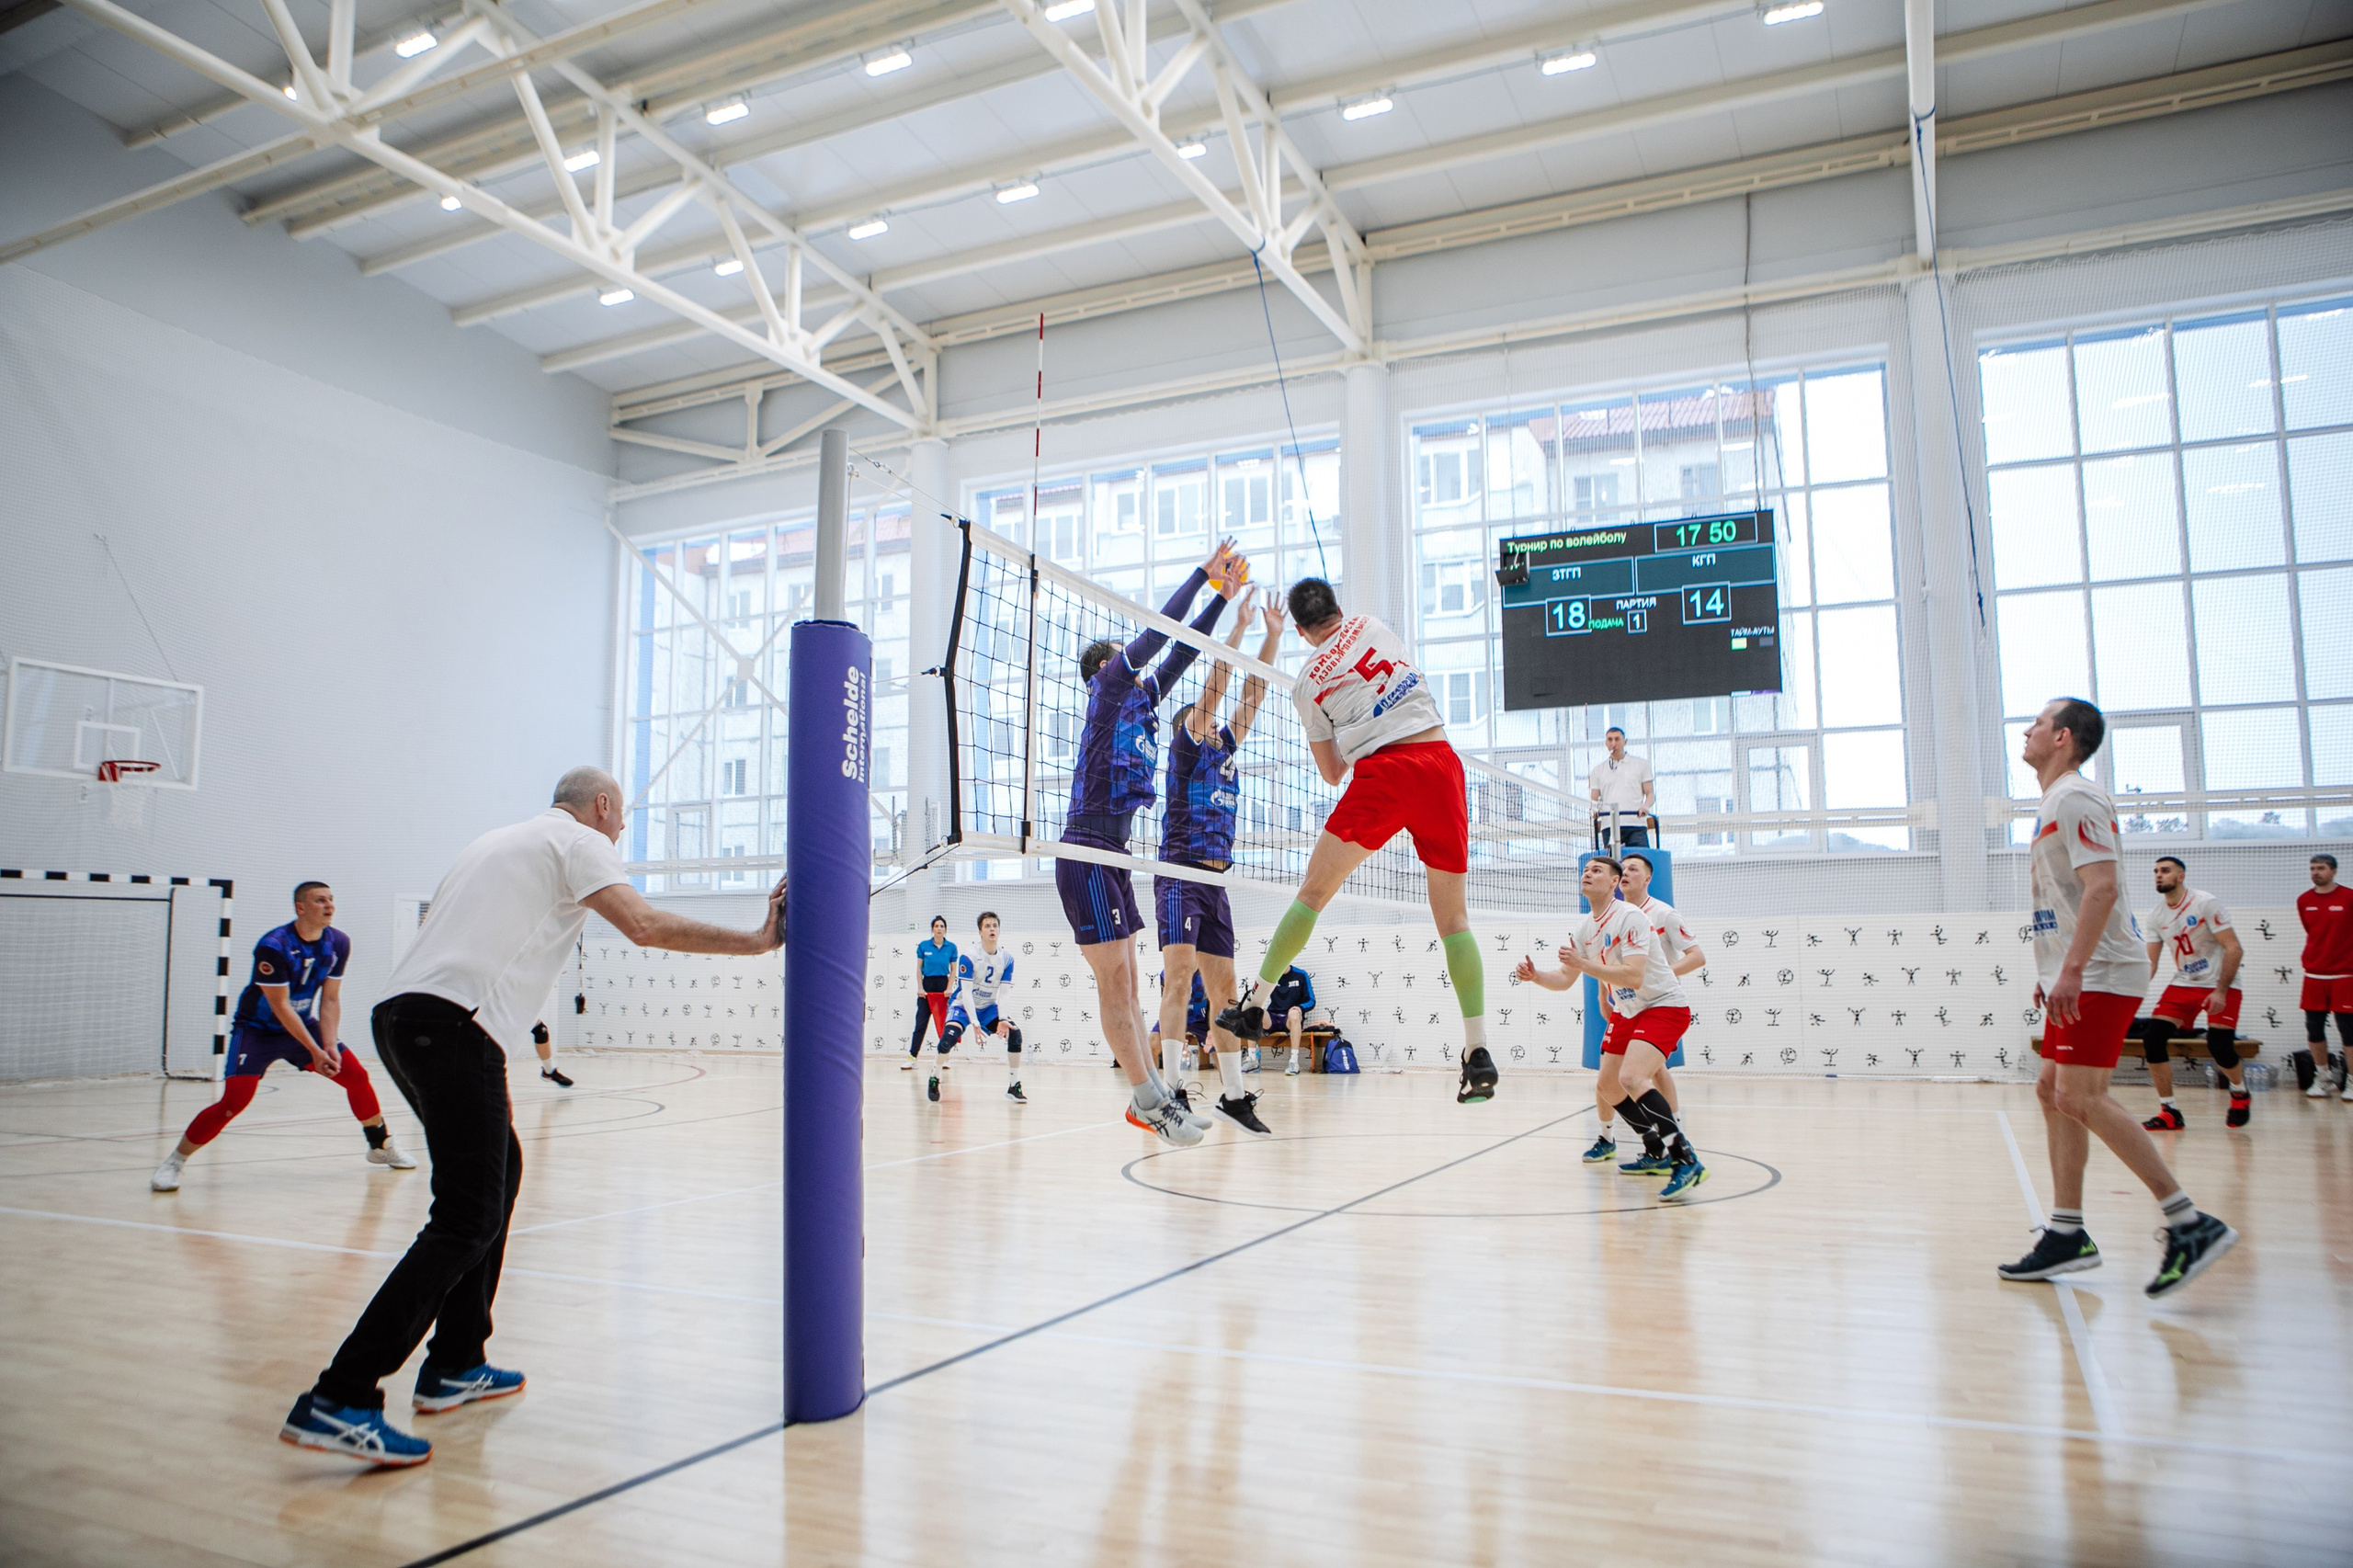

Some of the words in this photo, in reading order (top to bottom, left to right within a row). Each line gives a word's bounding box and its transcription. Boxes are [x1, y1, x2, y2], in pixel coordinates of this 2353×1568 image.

[1507, 539, 1548, 553] Турнир
[1550, 539, 1563, 550] по
[1566, 530, 1627, 549] волейболу
[1676, 524, 1700, 547] 17
[1709, 520, 1737, 543] 50
[1691, 553, 1716, 568] КГП
[1552, 567, 1582, 581] ЗТГП
[1616, 597, 1657, 611] ПАРТИЯ
[1689, 588, 1724, 618] 14
[1552, 601, 1586, 631] 18
[1588, 617, 1624, 630] ПОДАЧА
[1632, 614, 1641, 629] 1
[1353, 646, 1394, 695] 5
[841, 665, 859, 780] Schelde
[858, 671, 867, 783] International
[1220, 754, 1235, 782] 4
[1111, 908, 1121, 925] 3
[1185, 916, 1192, 931] 4
[302, 958, 316, 984] 7
[984, 966, 995, 983] 2
[239, 1054, 246, 1064] 7
